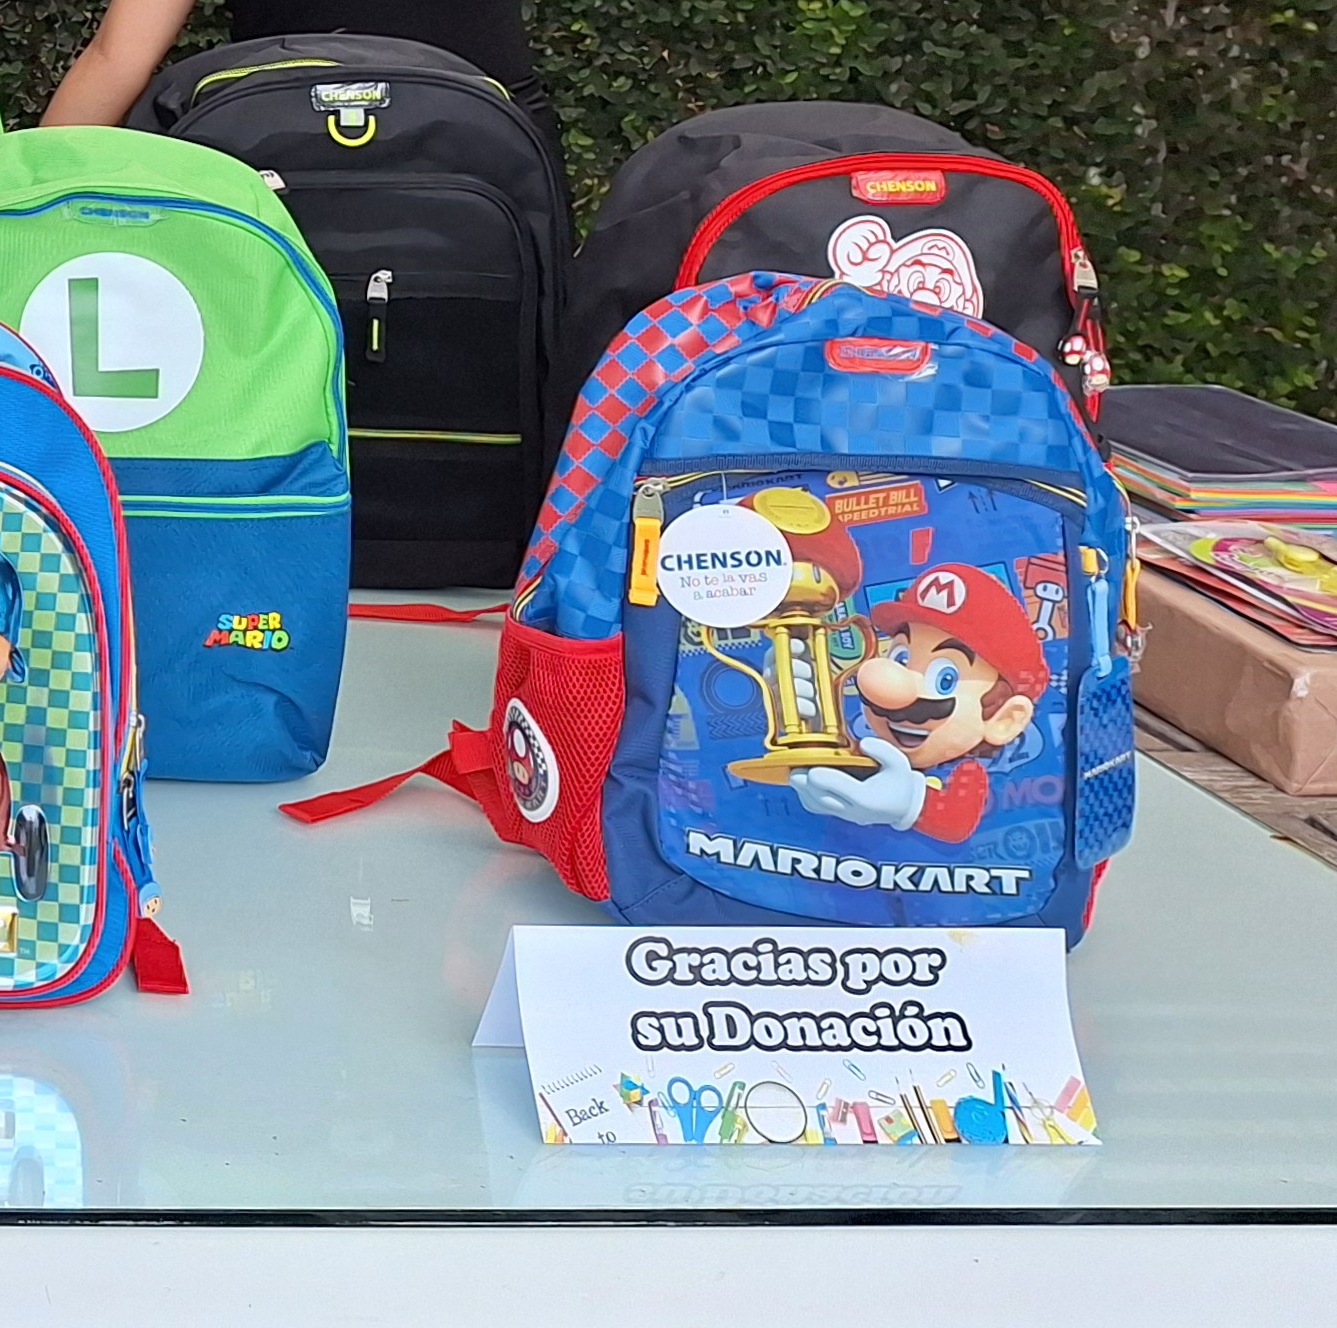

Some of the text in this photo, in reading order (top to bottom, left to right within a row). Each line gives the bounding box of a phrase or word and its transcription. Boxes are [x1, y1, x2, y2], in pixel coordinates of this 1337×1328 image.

[320, 89, 382, 102] CHENSON
[866, 179, 937, 193] CHENSON
[68, 277, 161, 399] L
[834, 488, 919, 514] BULLET BILL
[660, 549, 783, 572] CHENSON
[679, 572, 768, 589] No te la vas
[693, 585, 757, 601] a acabar
[216, 610, 282, 631] SUPER
[202, 628, 291, 652] MARIO
[686, 827, 1032, 896] MARIOKART
[625, 936, 948, 996] Gracias por
[629, 999, 974, 1052] su Donación
[564, 1097, 610, 1127] Back
